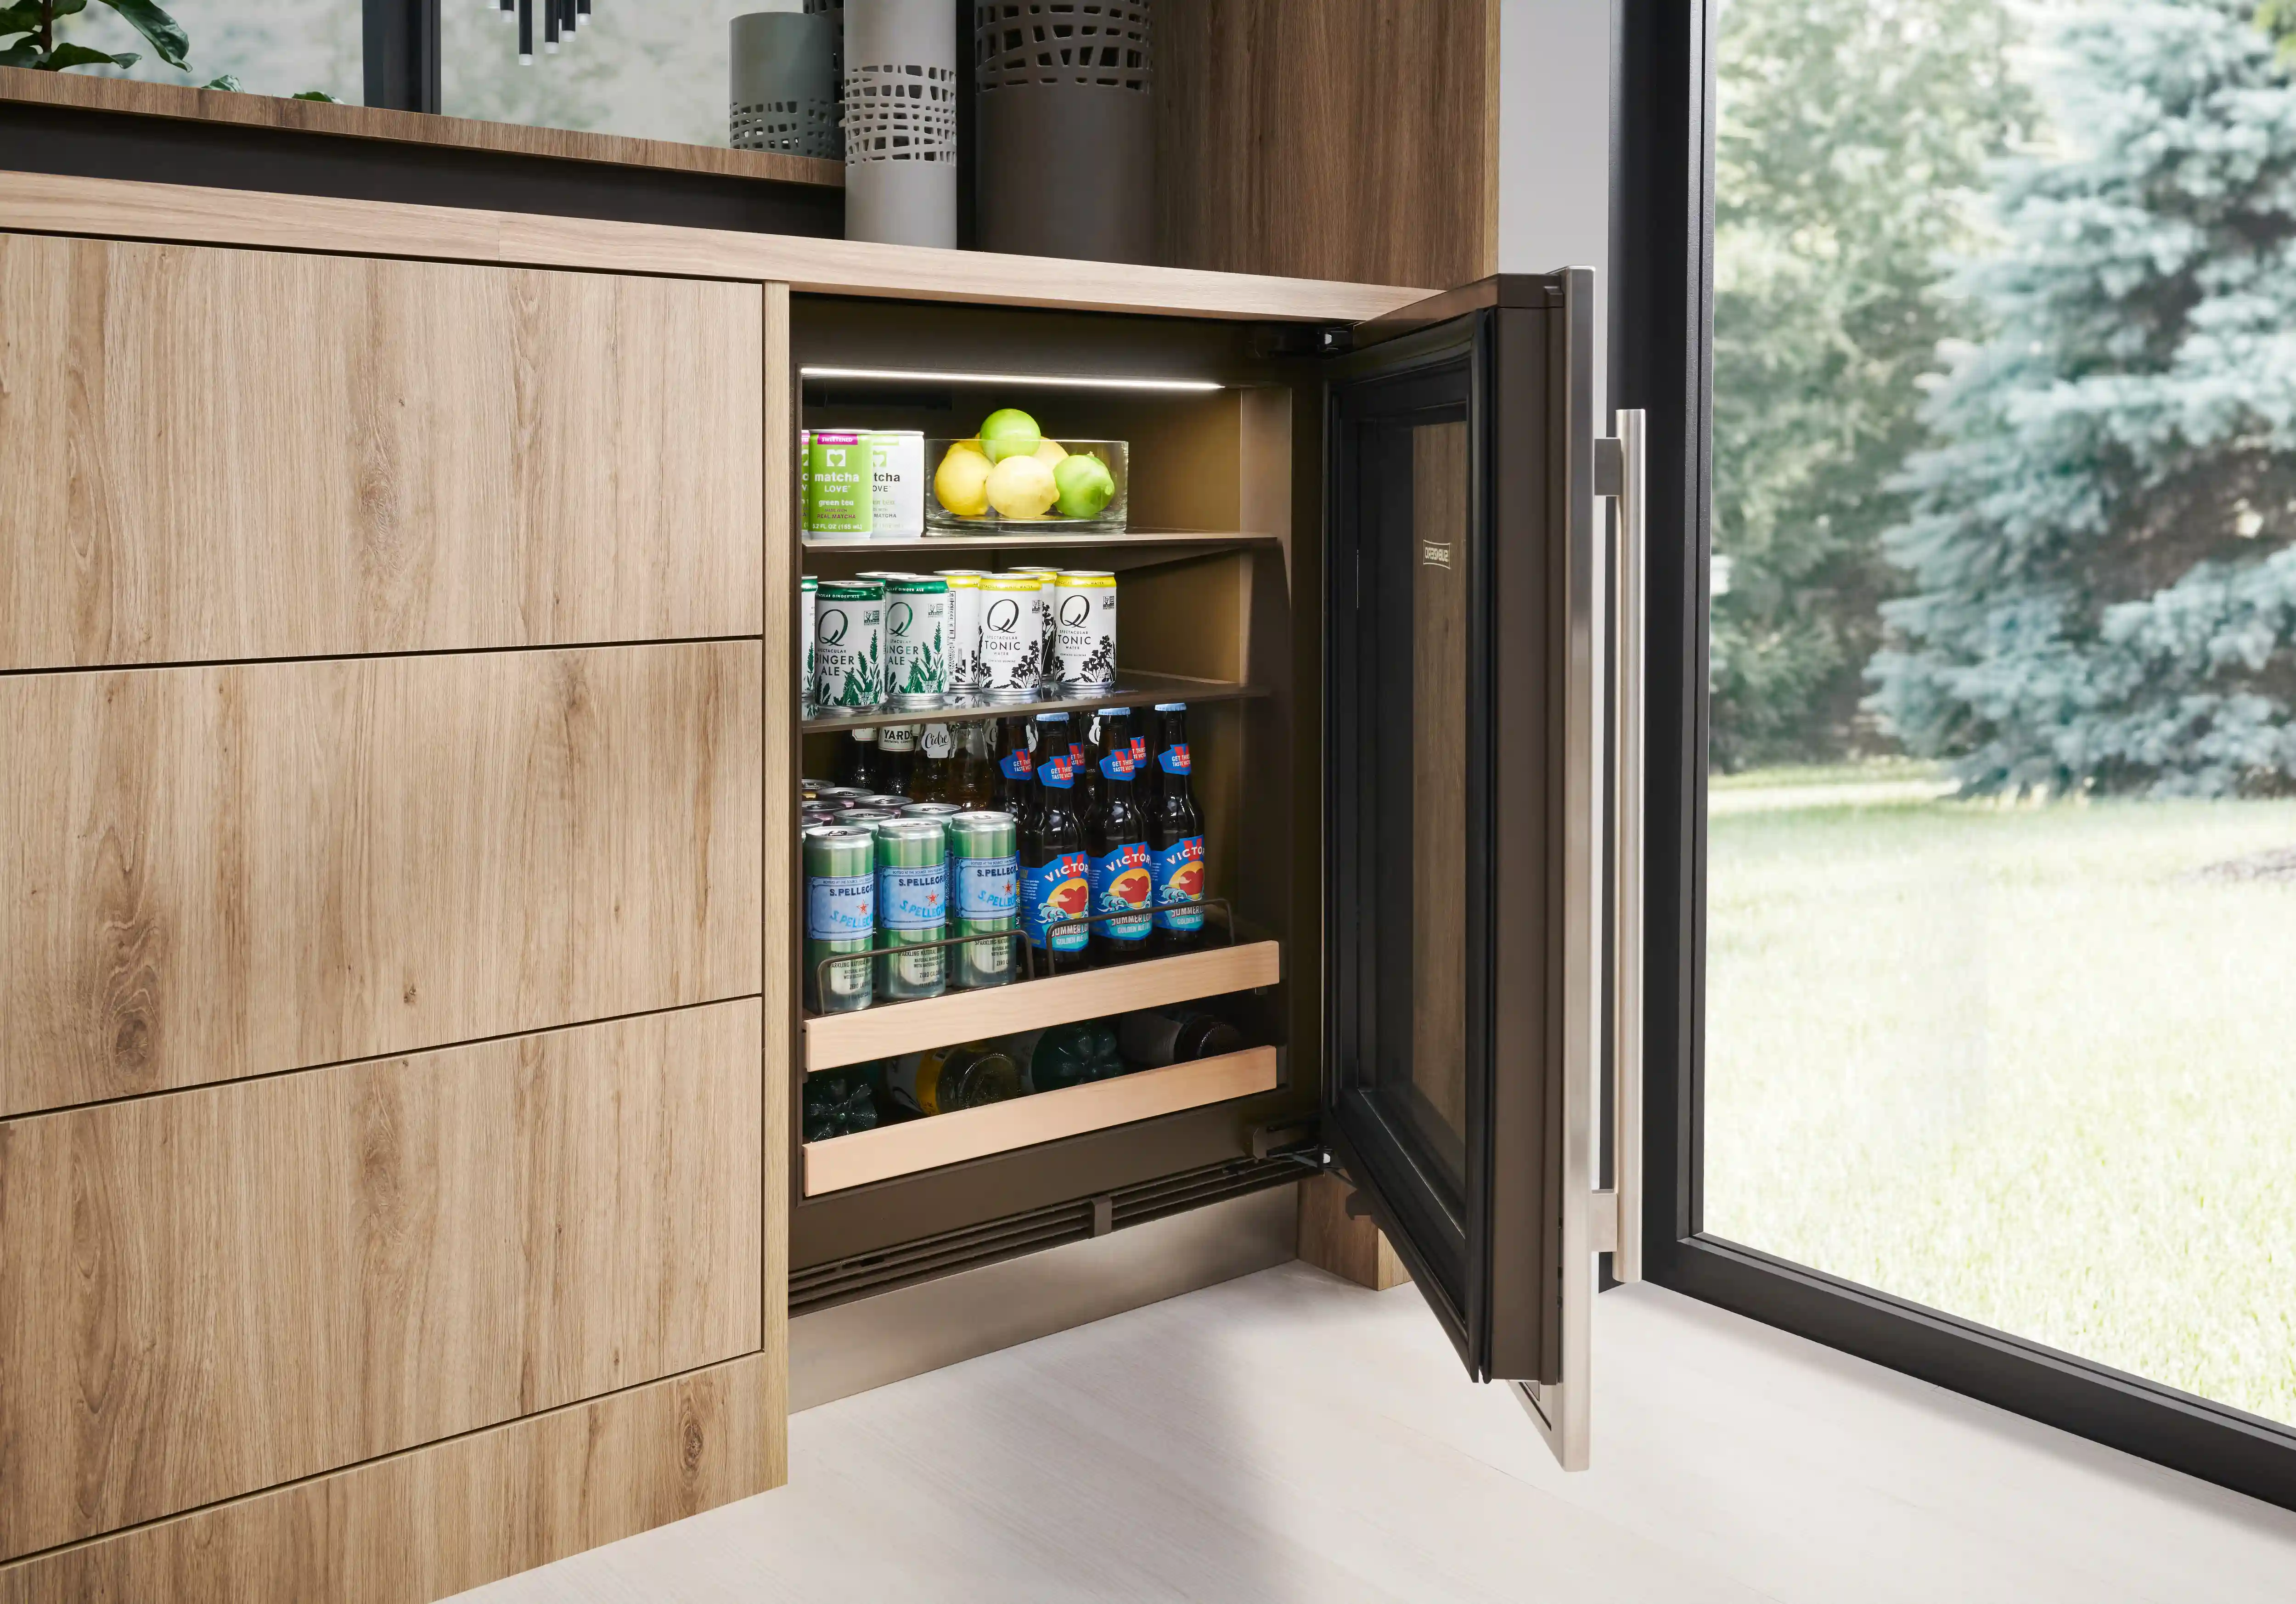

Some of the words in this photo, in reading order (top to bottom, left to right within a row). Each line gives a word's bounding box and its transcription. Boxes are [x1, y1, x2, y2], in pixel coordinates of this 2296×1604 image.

[815, 472, 860, 482] matcha
[873, 472, 900, 482] tcha
[987, 599, 1019, 633] Q
[1060, 595, 1090, 628] Q
[885, 602, 913, 637] Q
[818, 609, 848, 646] Q
[985, 640, 1020, 650] TONIC
[1058, 634, 1091, 645] TONIC
[815, 653, 855, 665] GINGER
[888, 655, 905, 665] ALE
[821, 666, 839, 676] ALE
[925, 731, 949, 749] Cidre
[1106, 853, 1151, 871] VICTOR
[1044, 863, 1089, 882] VICTOR
[1117, 926, 1137, 934] GOLDEN
[1056, 937, 1075, 945] GOLDEN
